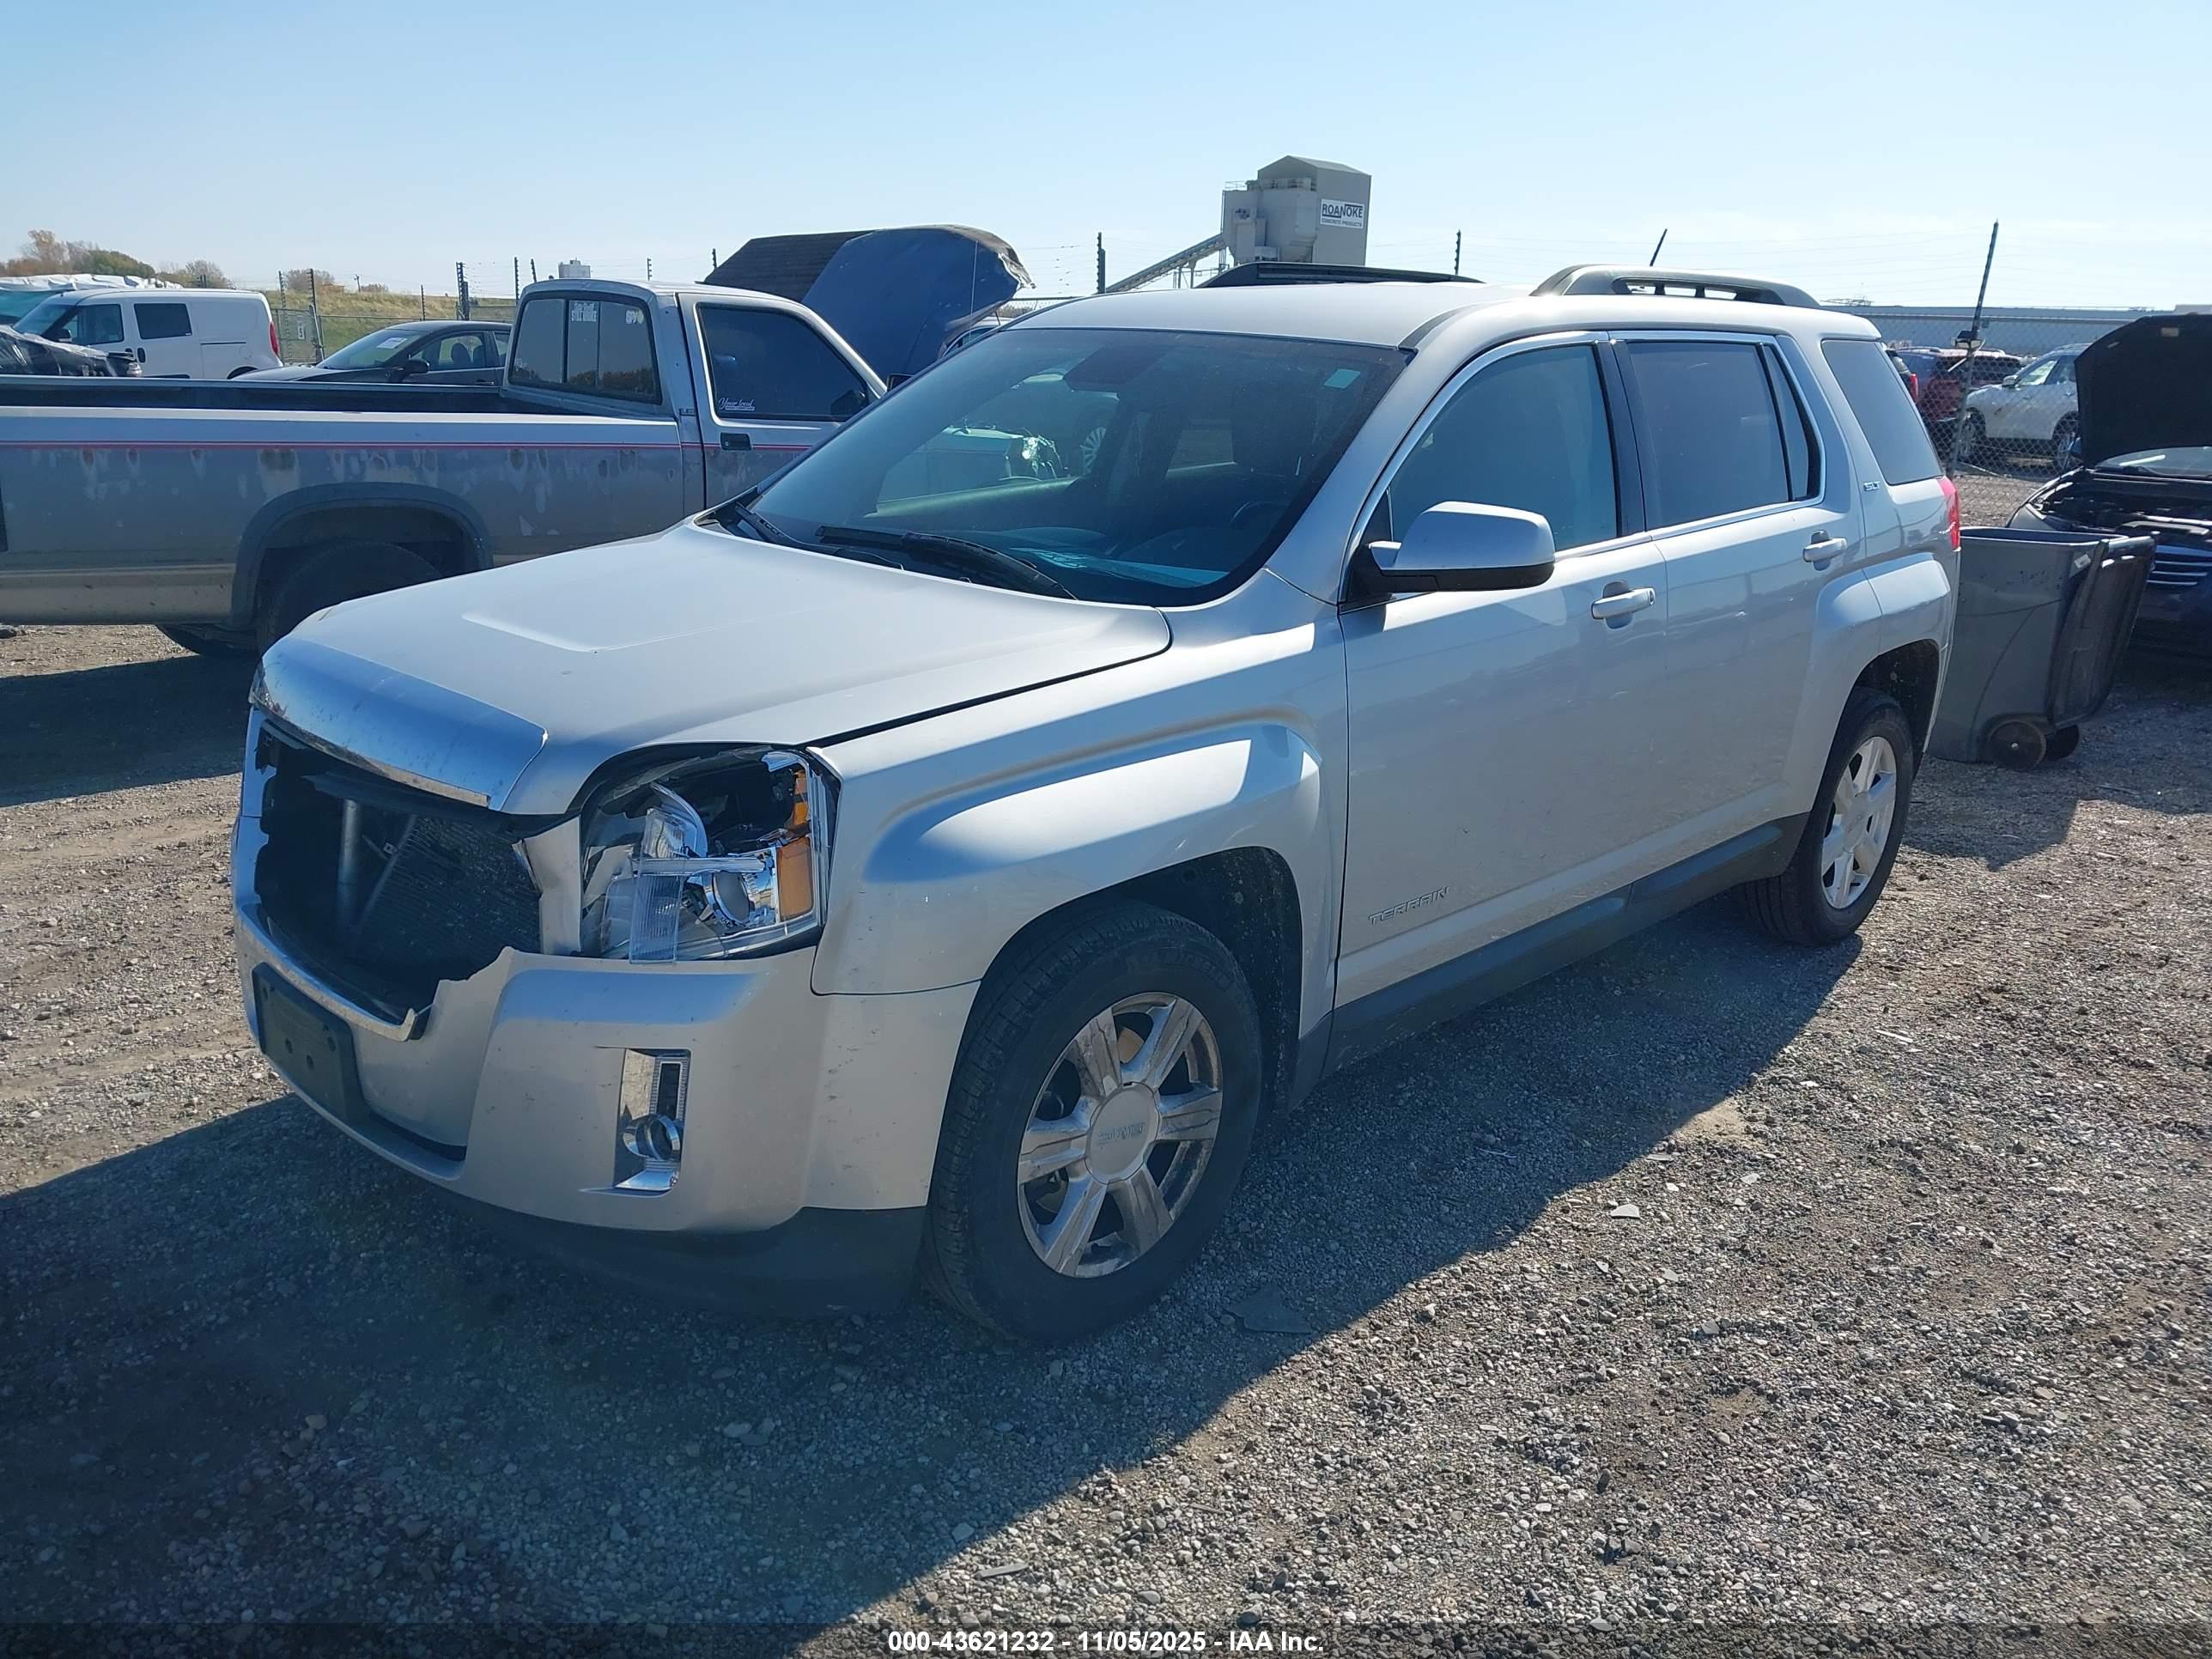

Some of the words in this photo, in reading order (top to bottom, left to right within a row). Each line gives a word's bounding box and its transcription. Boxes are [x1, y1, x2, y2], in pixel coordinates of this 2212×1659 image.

[1322, 204, 1364, 218] ROANOKE
[719, 398, 738, 410] Your
[1863, 481, 1881, 491] SLT
[1368, 886, 1450, 925] TERRAIN
